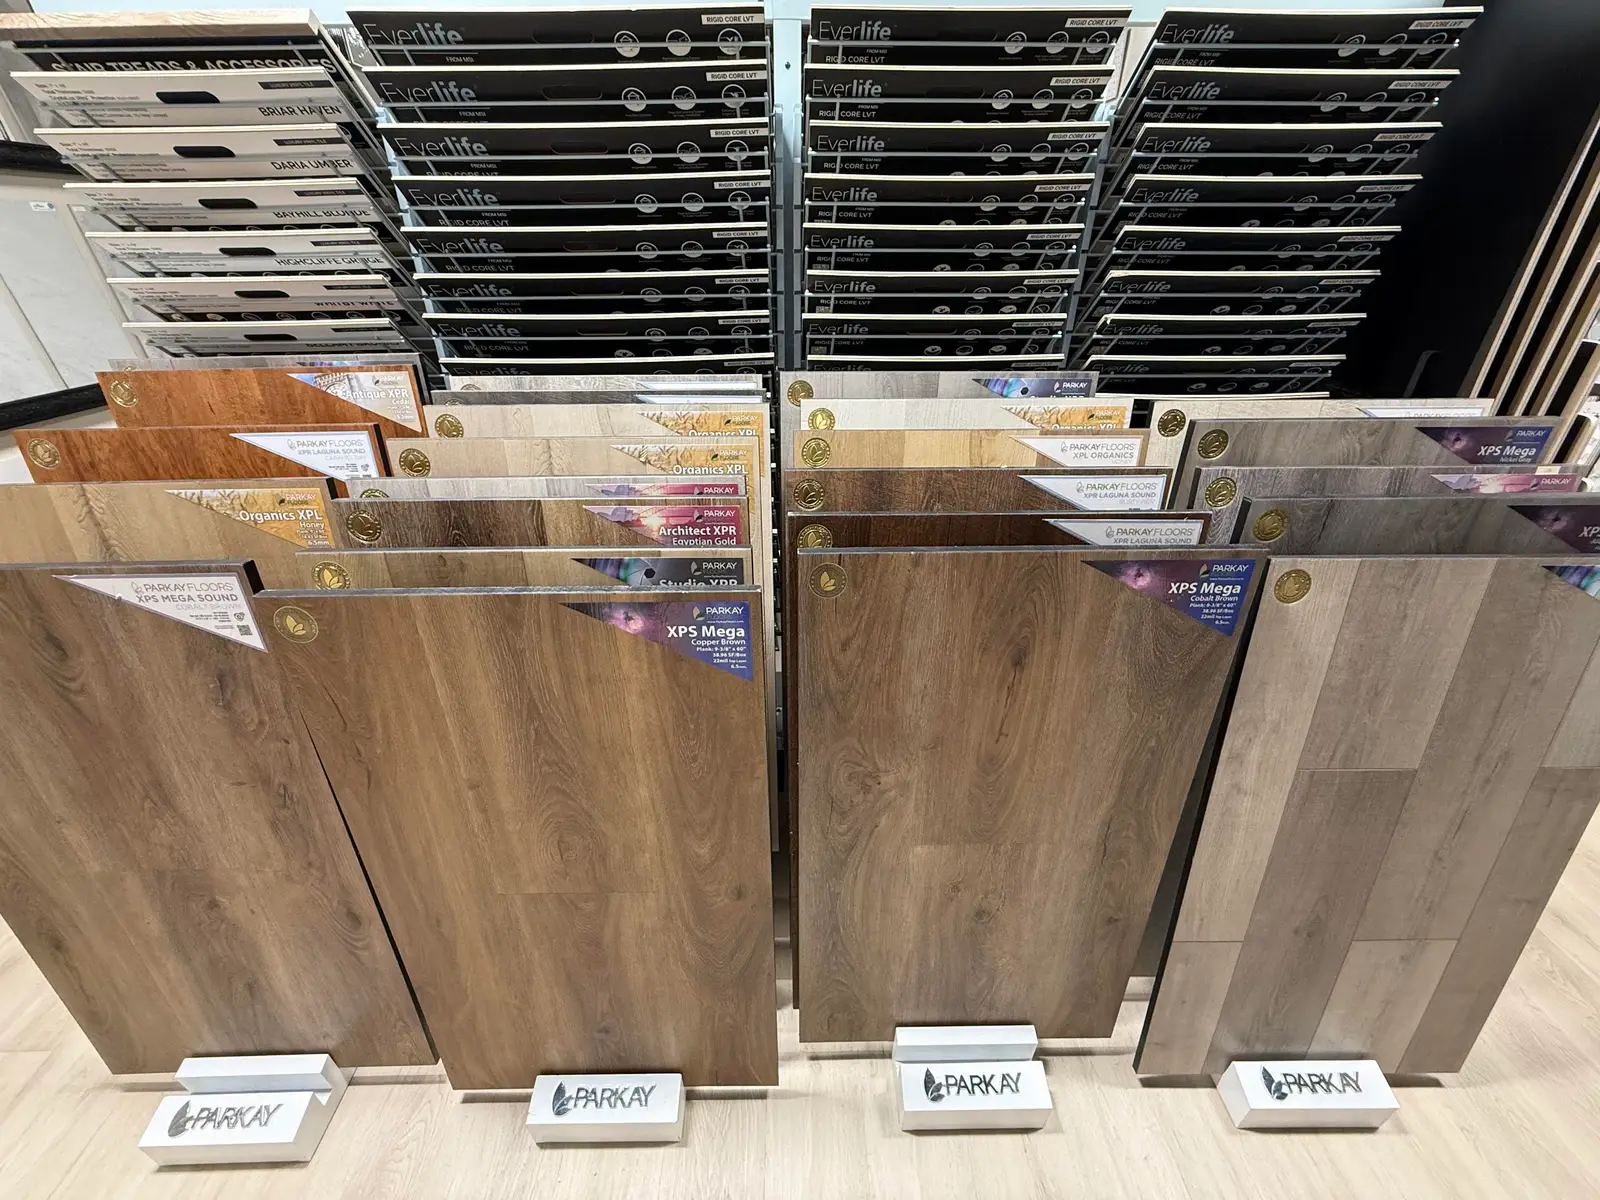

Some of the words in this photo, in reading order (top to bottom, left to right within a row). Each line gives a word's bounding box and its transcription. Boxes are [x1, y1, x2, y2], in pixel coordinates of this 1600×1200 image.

[363, 22, 464, 45] Everlife
[819, 20, 891, 41] Everlife
[1159, 23, 1235, 44] Everlife
[1176, 58, 1198, 66] CORE
[379, 80, 477, 102] Everlife
[812, 79, 882, 97] Everlife
[1148, 81, 1221, 100] Everlife
[258, 106, 299, 117] BRIAR
[394, 136, 489, 156] Everlife
[817, 135, 885, 151] Everlife
[1141, 136, 1212, 153] Everlife
[270, 160, 310, 170] DARIA
[408, 188, 500, 206] Everlife
[812, 187, 878, 201] Everlife
[1131, 188, 1200, 202] Everlife
[416, 237, 504, 253] Everlife
[810, 234, 874, 248] Everlife
[1120, 237, 1186, 250] Everlife
[427, 284, 512, 297] Everlife
[814, 280, 876, 293] Everlife
[1107, 281, 1171, 293] Everlife
[437, 323, 521, 336] Everlife
[809, 324, 868, 334] Everlife
[1102, 323, 1164, 335] Everlife
[346, 389, 386, 400] Antique
[387, 389, 409, 398] XPR
[1090, 451, 1134, 459] ORGANICS
[1478, 446, 1503, 456] XPS
[1503, 446, 1536, 458] Mega
[672, 464, 724, 474] Organics
[726, 464, 748, 474] XPL
[239, 510, 296, 524] Organics
[296, 509, 323, 521] XPL
[300, 521, 325, 530] Honey
[659, 525, 711, 536] Architect
[713, 526, 736, 536] XPR
[672, 537, 713, 545] Egyptian
[714, 537, 737, 545] Gold
[702, 561, 737, 569] PARKAY
[1212, 564, 1249, 572] PARKAY
[1168, 582, 1197, 594] XPS
[1200, 583, 1241, 596] Mega
[136, 595, 158, 603] XPS
[161, 594, 195, 603] MEGA
[198, 593, 239, 602] SOUND
[705, 606, 744, 615] PARKAY
[666, 625, 698, 638] XPS
[701, 625, 745, 640] Mega
[691, 638, 719, 647] Copper
[720, 638, 746, 646] Brown
[944, 1071, 1021, 1096] PARKAY
[1280, 1071, 1364, 1095] PARKAY
[573, 1084, 657, 1109] PARKAY
[190, 1103, 285, 1130] PARKAY
